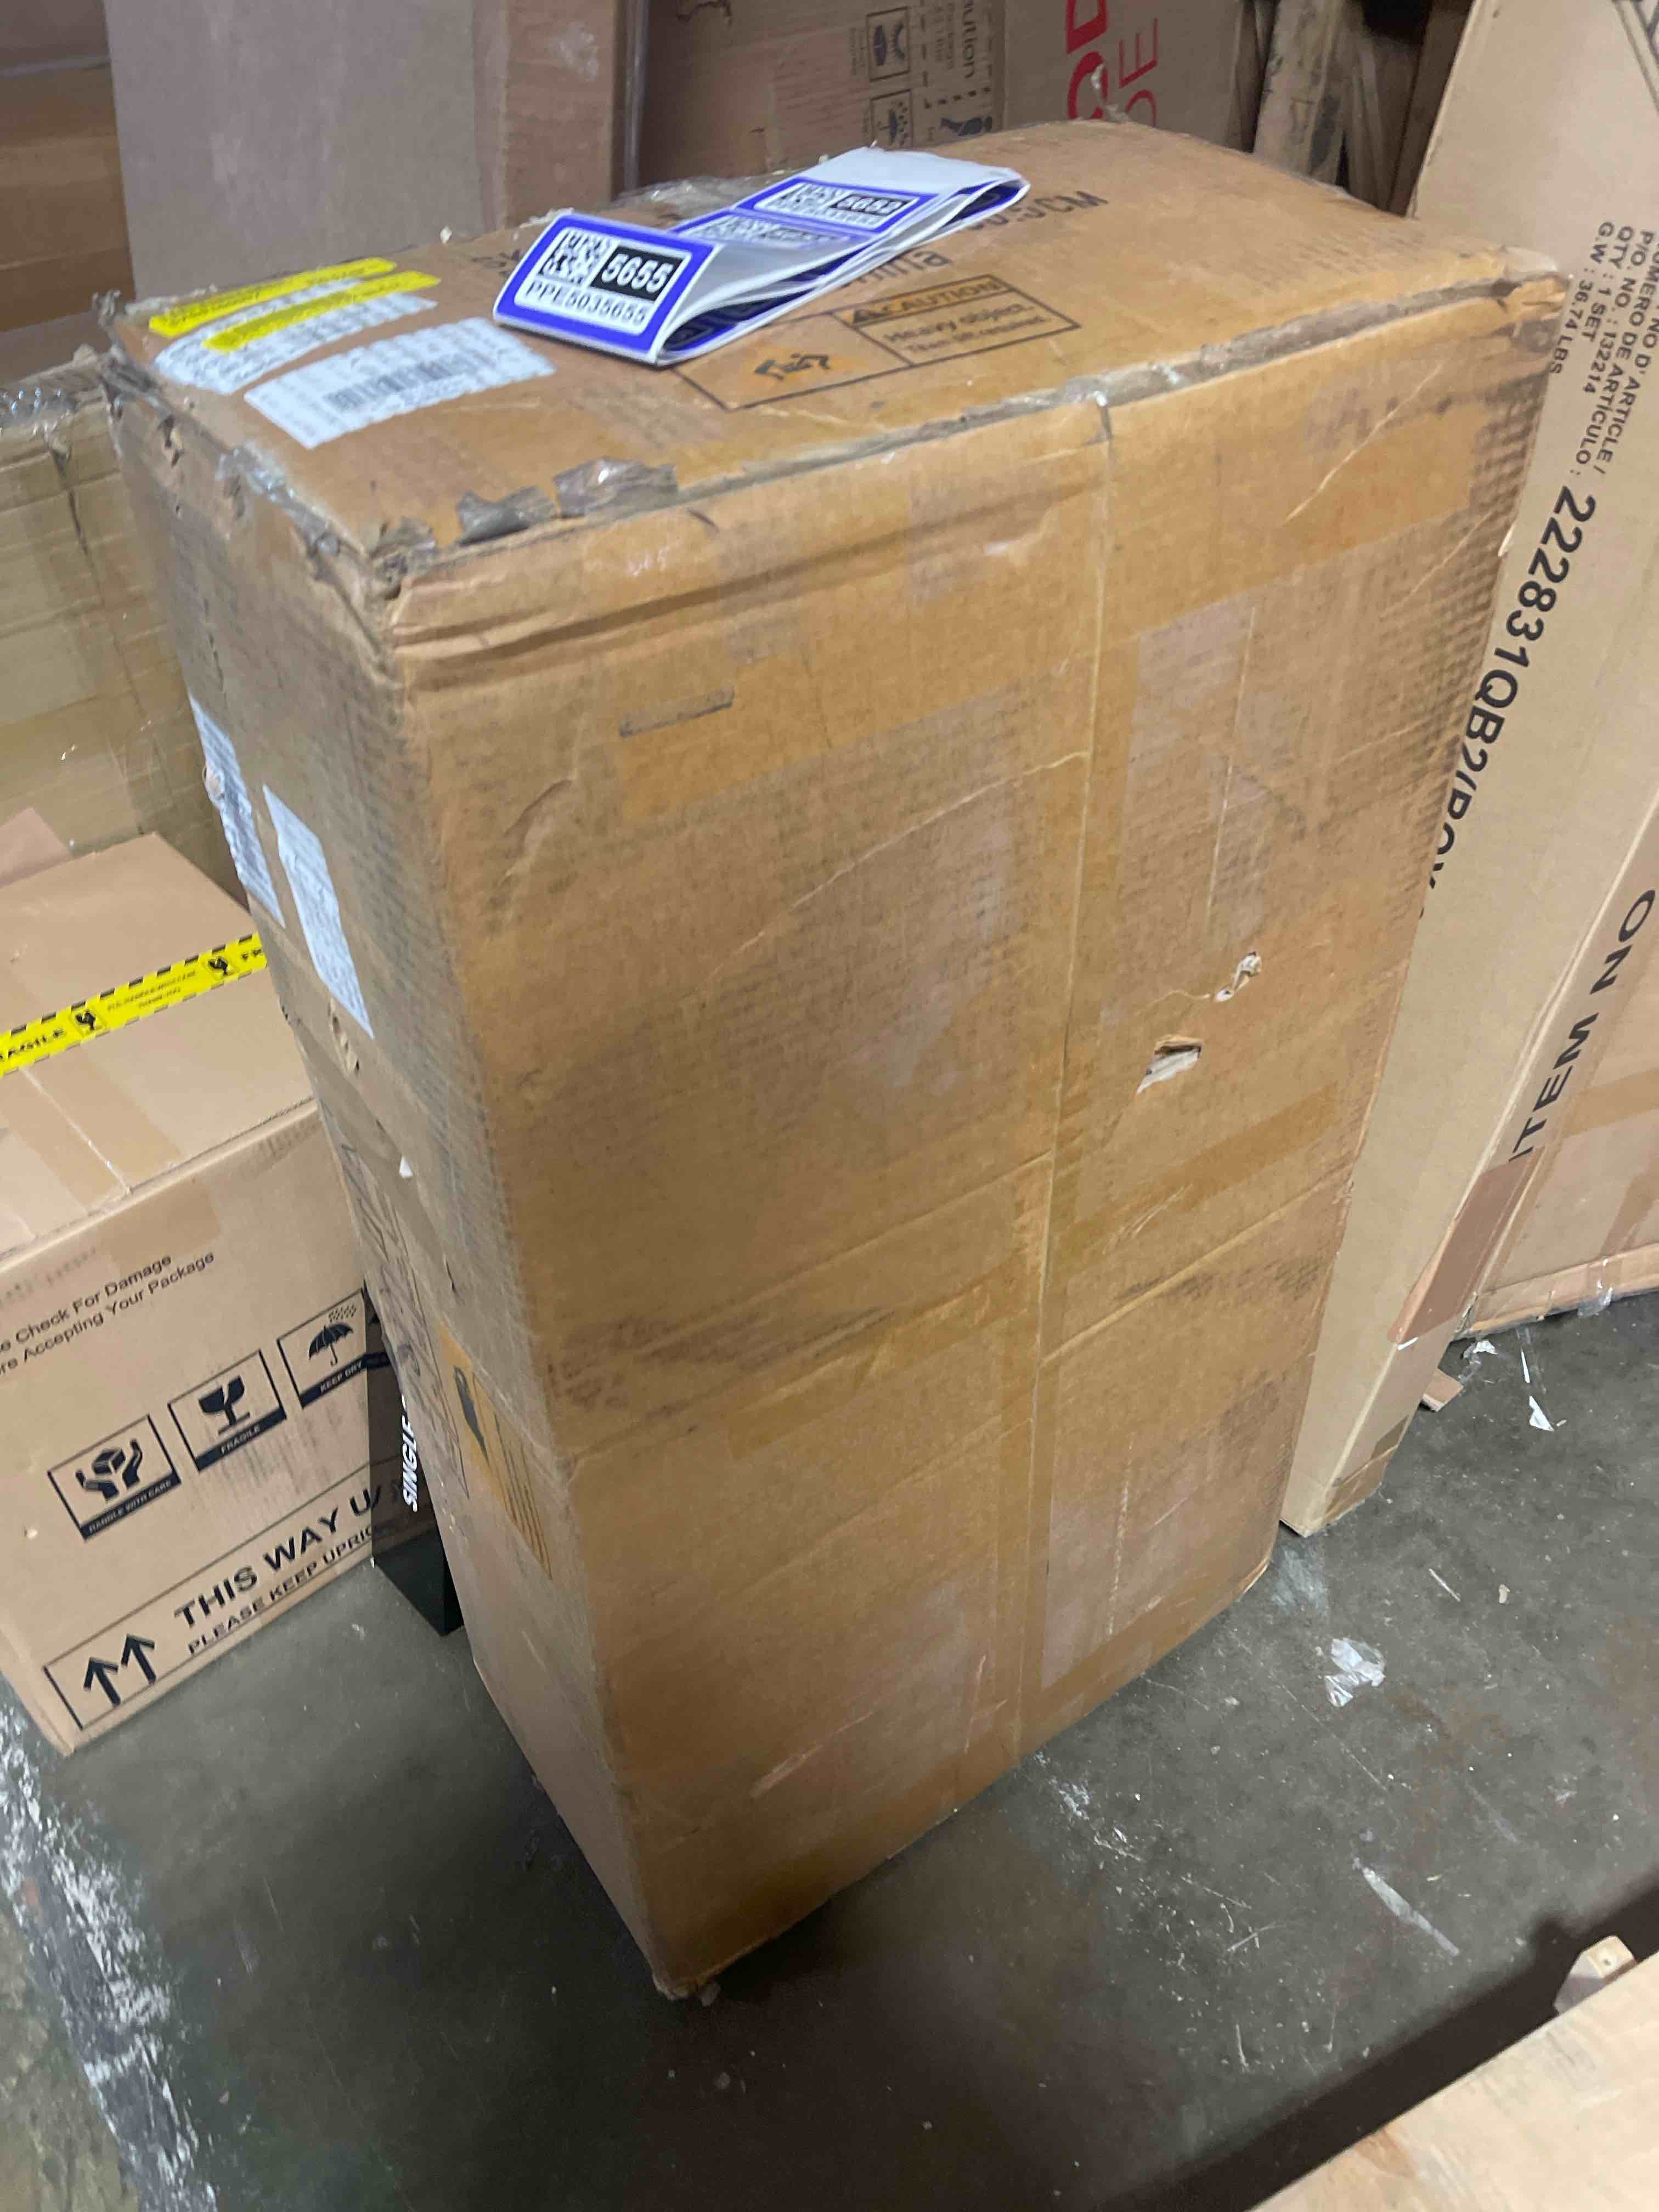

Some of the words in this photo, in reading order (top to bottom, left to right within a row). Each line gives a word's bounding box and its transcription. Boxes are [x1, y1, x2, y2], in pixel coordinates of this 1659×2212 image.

[1609, 225, 1634, 269] QTY
[602, 253, 674, 293] 5655
[1565, 279, 1593, 329] 36.74
[1582, 302, 1607, 343] SET
[1550, 335, 1573, 374] LBS
[1583, 331, 1617, 393] 132214
[1616, 331, 1638, 360] DE
[1508, 1012, 1599, 1162] ITEM
[1590, 889, 1656, 995] NO
[15, 1308, 70, 1344] Check
[72, 1291, 100, 1315] For
[104, 1254, 172, 1297] Damage
[24, 1312, 104, 1362] Accepting
[106, 1289, 145, 1316] Your
[148, 1251, 215, 1294] Package
[320, 1373, 342, 1392] KEEP
[345, 1360, 362, 1378] DRY
[221, 1424, 261, 1454] FRAGILE
[173, 1565, 258, 1629] THIS
[263, 1506, 339, 1572] WAY
[187, 1597, 266, 1655] PLEASE
[269, 1561, 318, 1602] KEEP
